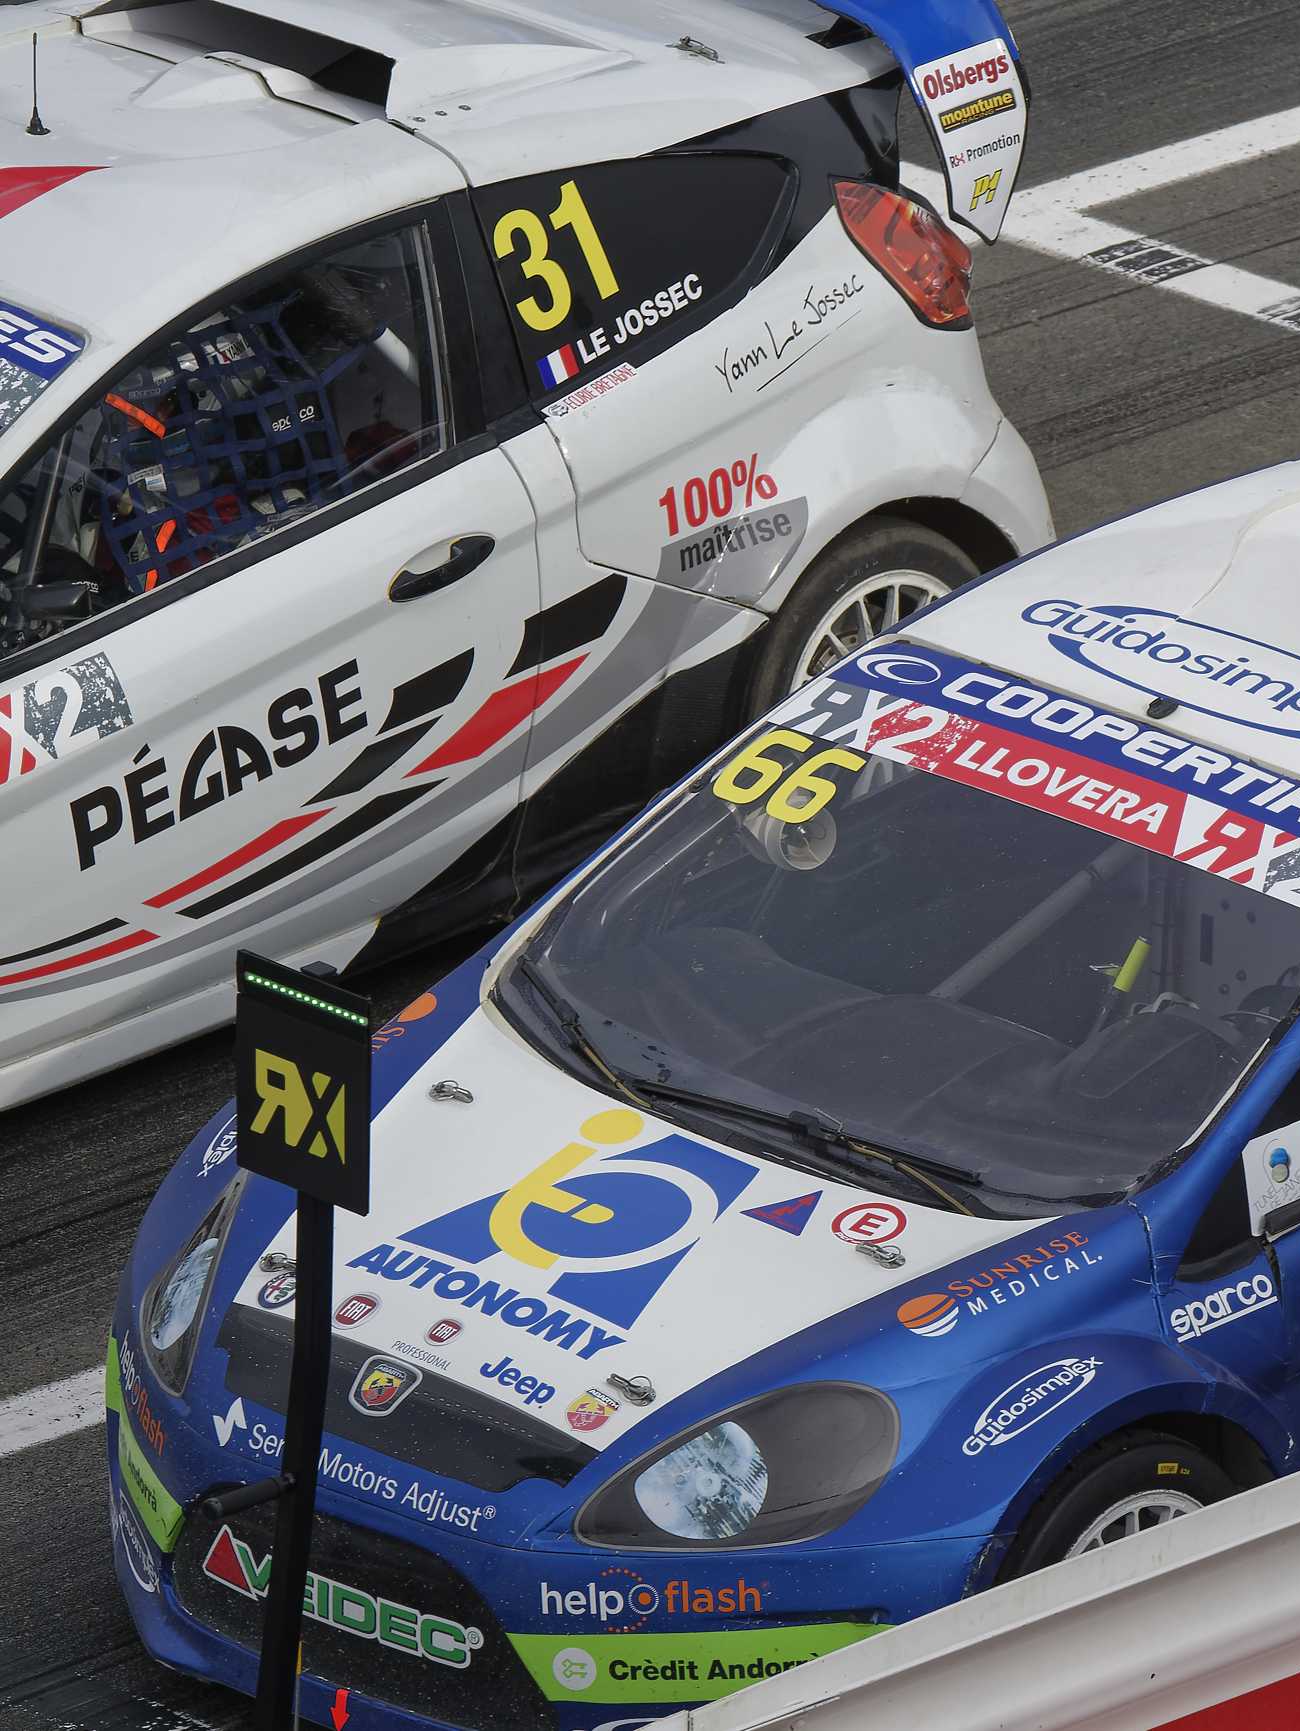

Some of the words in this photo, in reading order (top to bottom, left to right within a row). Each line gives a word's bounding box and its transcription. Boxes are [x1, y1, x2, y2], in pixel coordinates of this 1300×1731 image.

[923, 55, 1010, 100] Olsbergs
[942, 90, 1013, 127] mountune
[967, 133, 1021, 162] Promotion
[493, 180, 620, 332] 31
[577, 327, 611, 364] LE
[613, 273, 704, 345] JOSSEC
[715, 347, 767, 393] Yann
[765, 321, 803, 359] Le
[803, 274, 864, 325] Jossec
[592, 364, 638, 396] BRETAGNE
[658, 453, 778, 537] 100%
[680, 512, 793, 573] maîtrise
[69, 658, 369, 872] PÉGASE
[712, 729, 868, 825] 66
[954, 739, 1172, 836] LLOVERA
[848, 1212, 889, 1237] E
[946, 1230, 1090, 1298] SUNRISE
[339, 1300, 372, 1321] FIAT
[344, 1243, 627, 1361] AUTONOMY
[431, 1323, 458, 1341] FIAT
[1170, 1273, 1276, 1338] sparco
[391, 1340, 452, 1371] PROFESSIONAL
[479, 1356, 556, 1409] Jeep
[587, 1388, 621, 1412] ABARTH
[961, 1354, 1104, 1456] Guidosimplex
[248, 1423, 286, 1458] Ser
[317, 1447, 399, 1500] Motors
[540, 1582, 624, 1621] help
[608, 1658, 699, 1682] Crèdit
[707, 1652, 818, 1681] Andor
